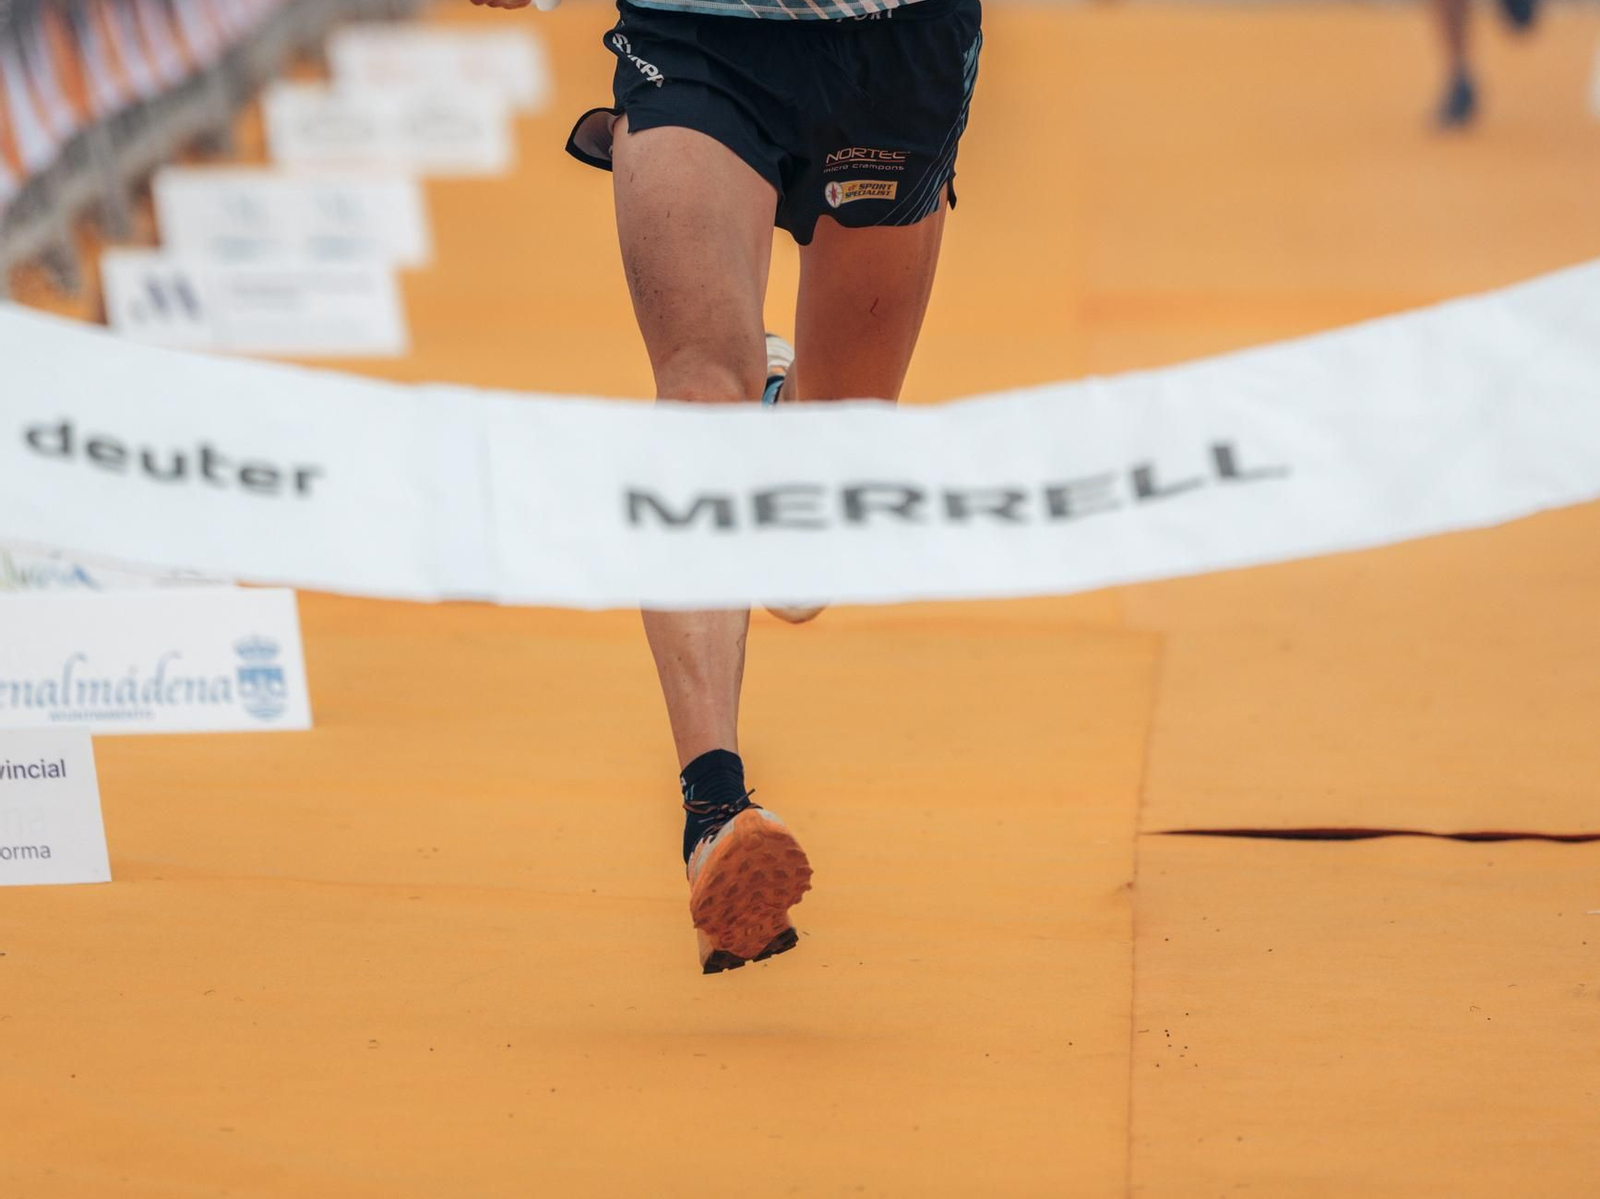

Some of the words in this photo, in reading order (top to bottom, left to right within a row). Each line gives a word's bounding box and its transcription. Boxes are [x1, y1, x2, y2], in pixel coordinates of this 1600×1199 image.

[826, 147, 907, 164] NORTEC
[823, 163, 849, 174] micro
[852, 163, 905, 172] crampons
[858, 183, 893, 191] SPORT
[844, 190, 892, 199] SPECIALIST
[22, 419, 327, 498] deuter
[622, 440, 1290, 533] MERRELL
